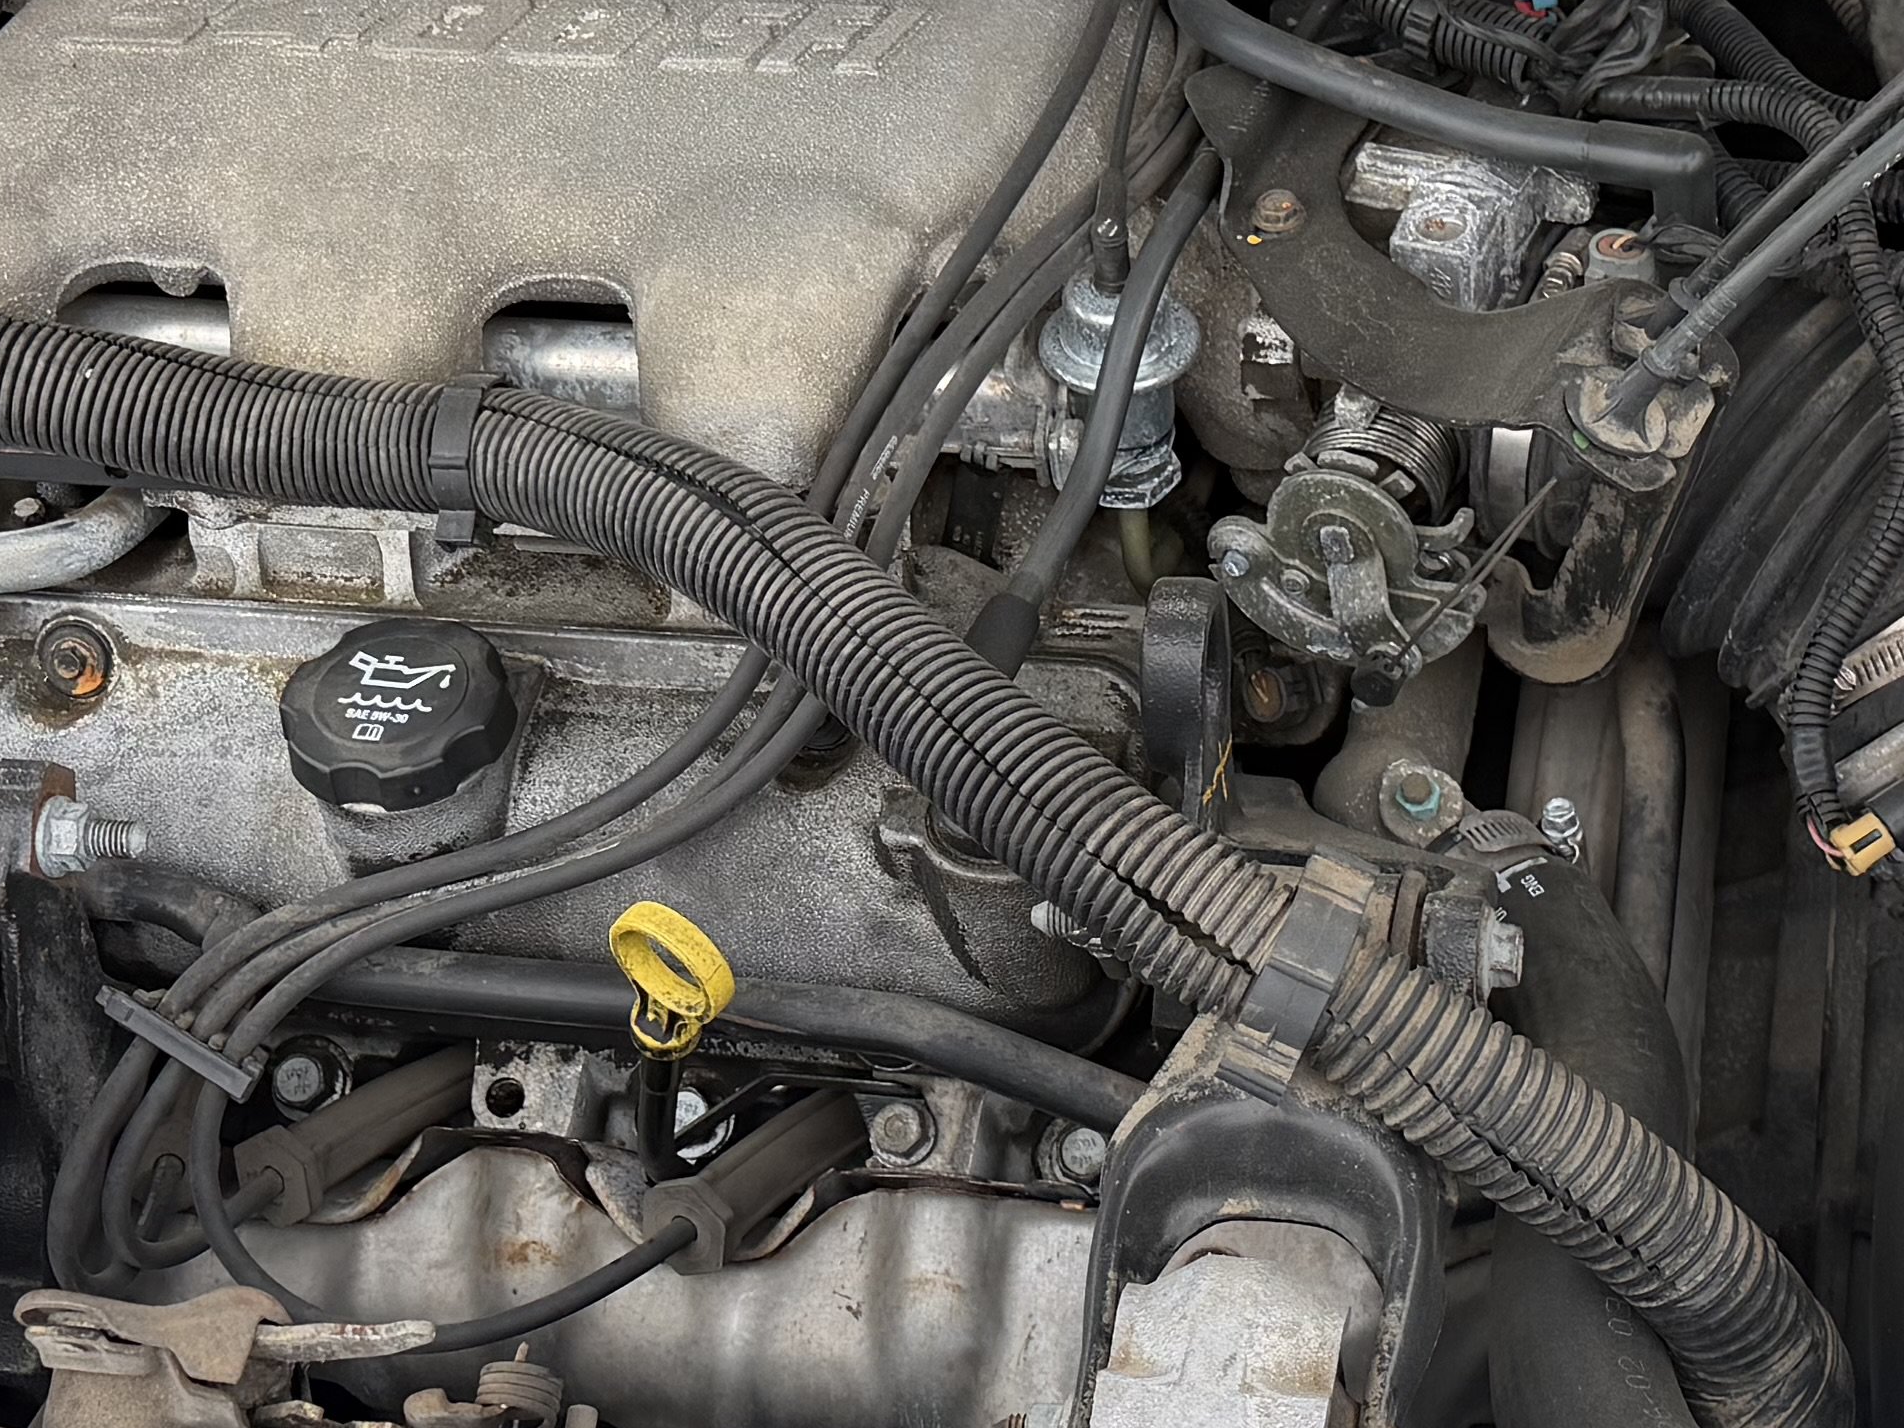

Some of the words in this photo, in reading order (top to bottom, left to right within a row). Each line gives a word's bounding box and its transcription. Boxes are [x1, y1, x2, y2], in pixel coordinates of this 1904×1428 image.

[843, 488, 871, 540] PREMIUM
[346, 709, 372, 720] SAE
[370, 710, 410, 724] 5W-30
